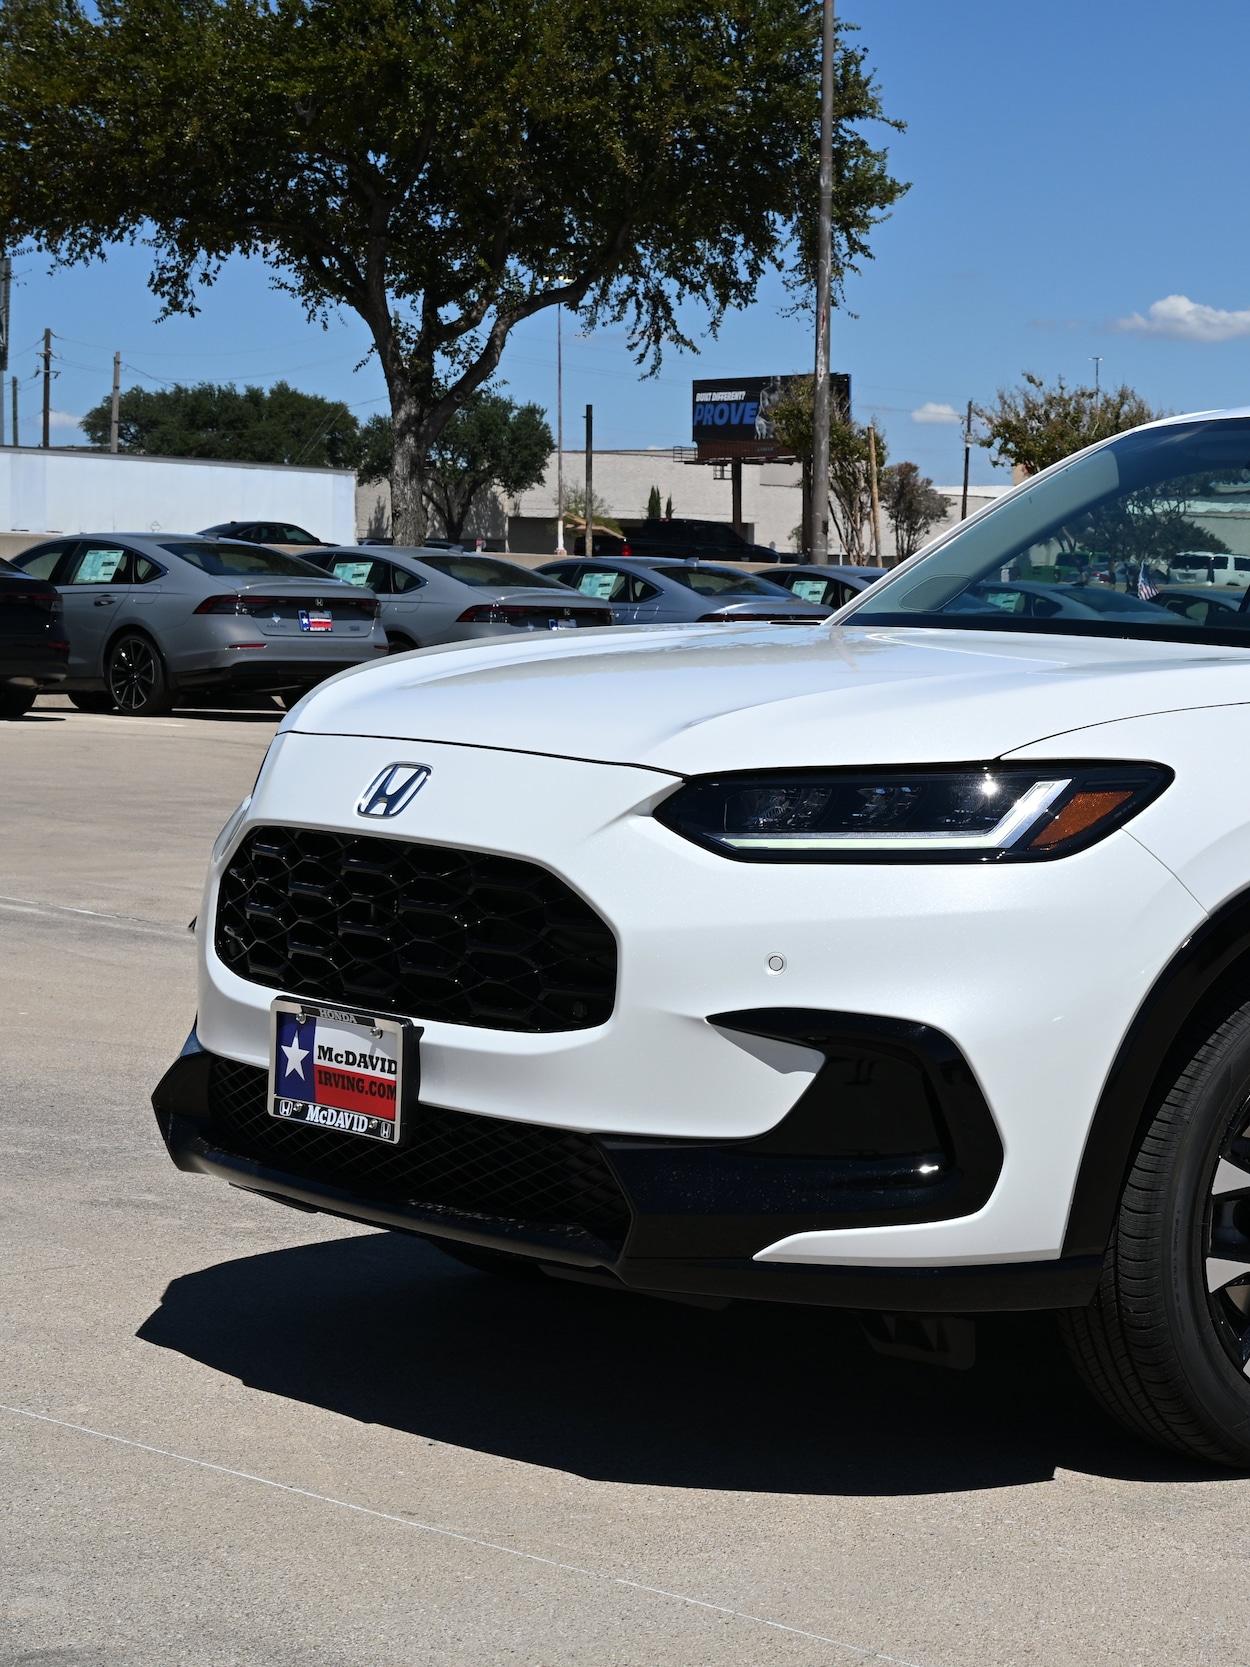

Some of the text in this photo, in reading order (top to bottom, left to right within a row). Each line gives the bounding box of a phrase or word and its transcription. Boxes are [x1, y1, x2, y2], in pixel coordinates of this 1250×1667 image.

[696, 390, 746, 402] BUILT DIFFERENT?
[694, 402, 759, 426] PROVE
[319, 1009, 358, 1024] HONDA
[317, 1045, 398, 1075] McDAVID
[317, 1069, 397, 1101] IRVING.COM
[305, 1104, 369, 1133] McDAVID
